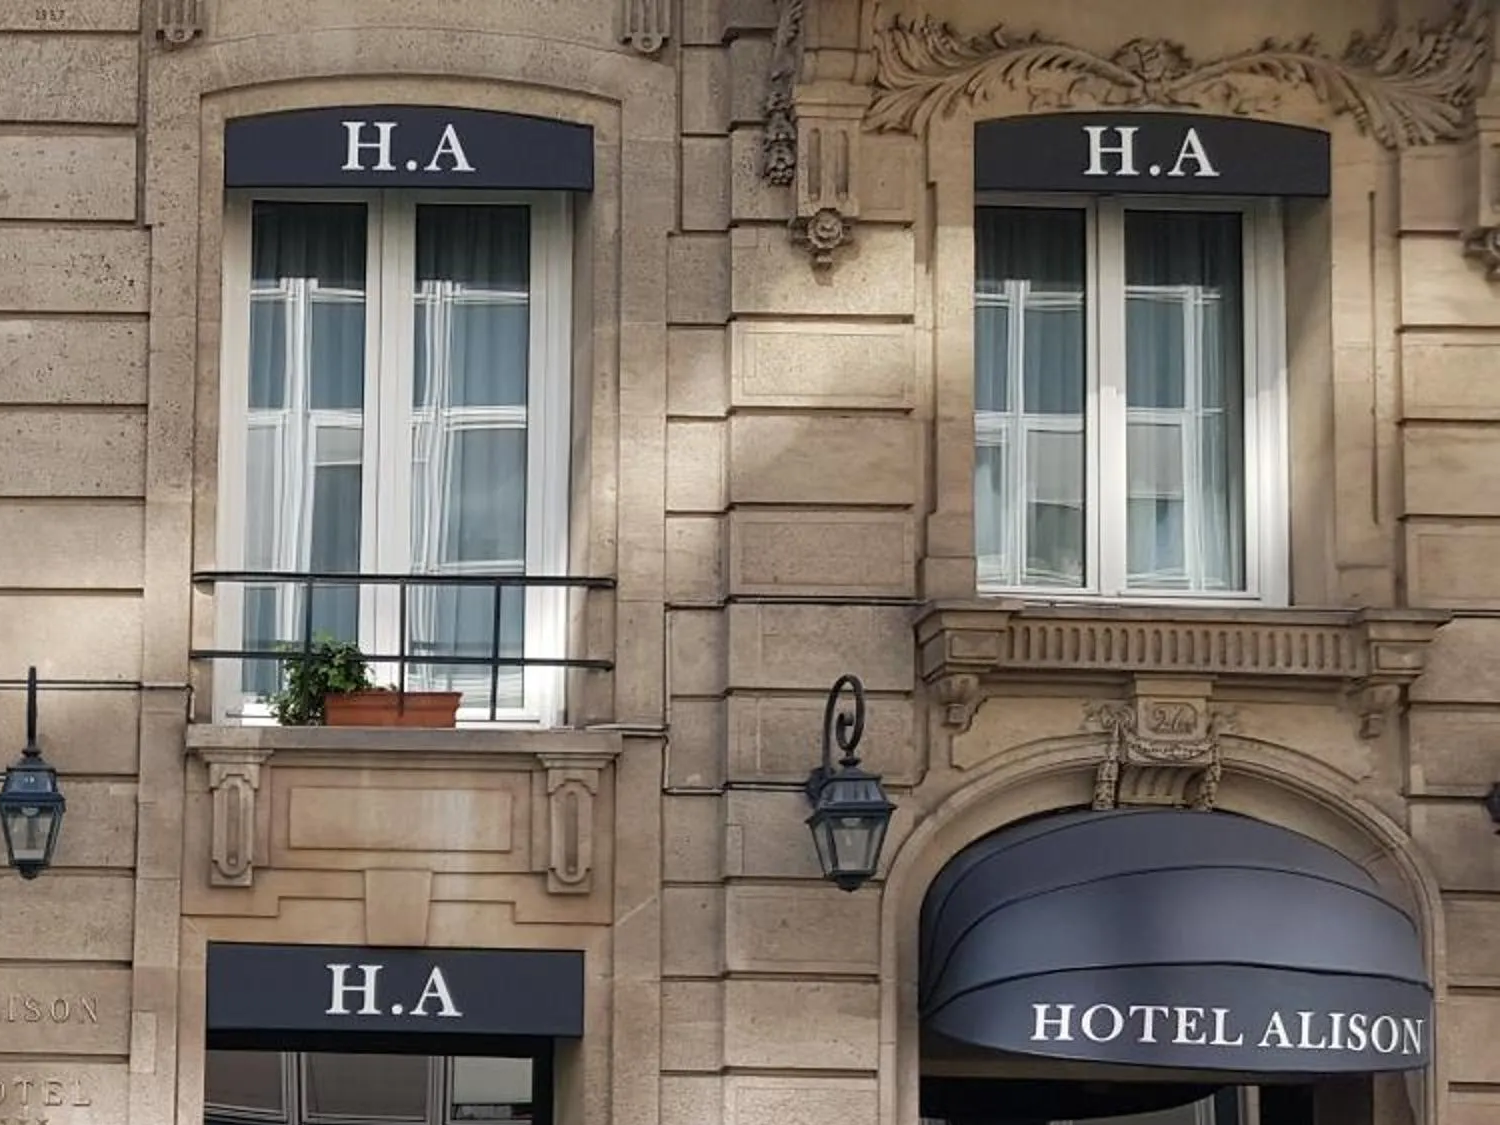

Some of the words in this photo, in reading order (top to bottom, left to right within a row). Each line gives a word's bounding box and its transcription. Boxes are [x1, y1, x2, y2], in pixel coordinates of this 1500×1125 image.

[341, 121, 475, 171] H.A
[1083, 126, 1219, 177] H.A
[325, 964, 462, 1017] H.A
[1030, 1003, 1244, 1046] HOTEL
[1257, 1011, 1424, 1055] ALISON
